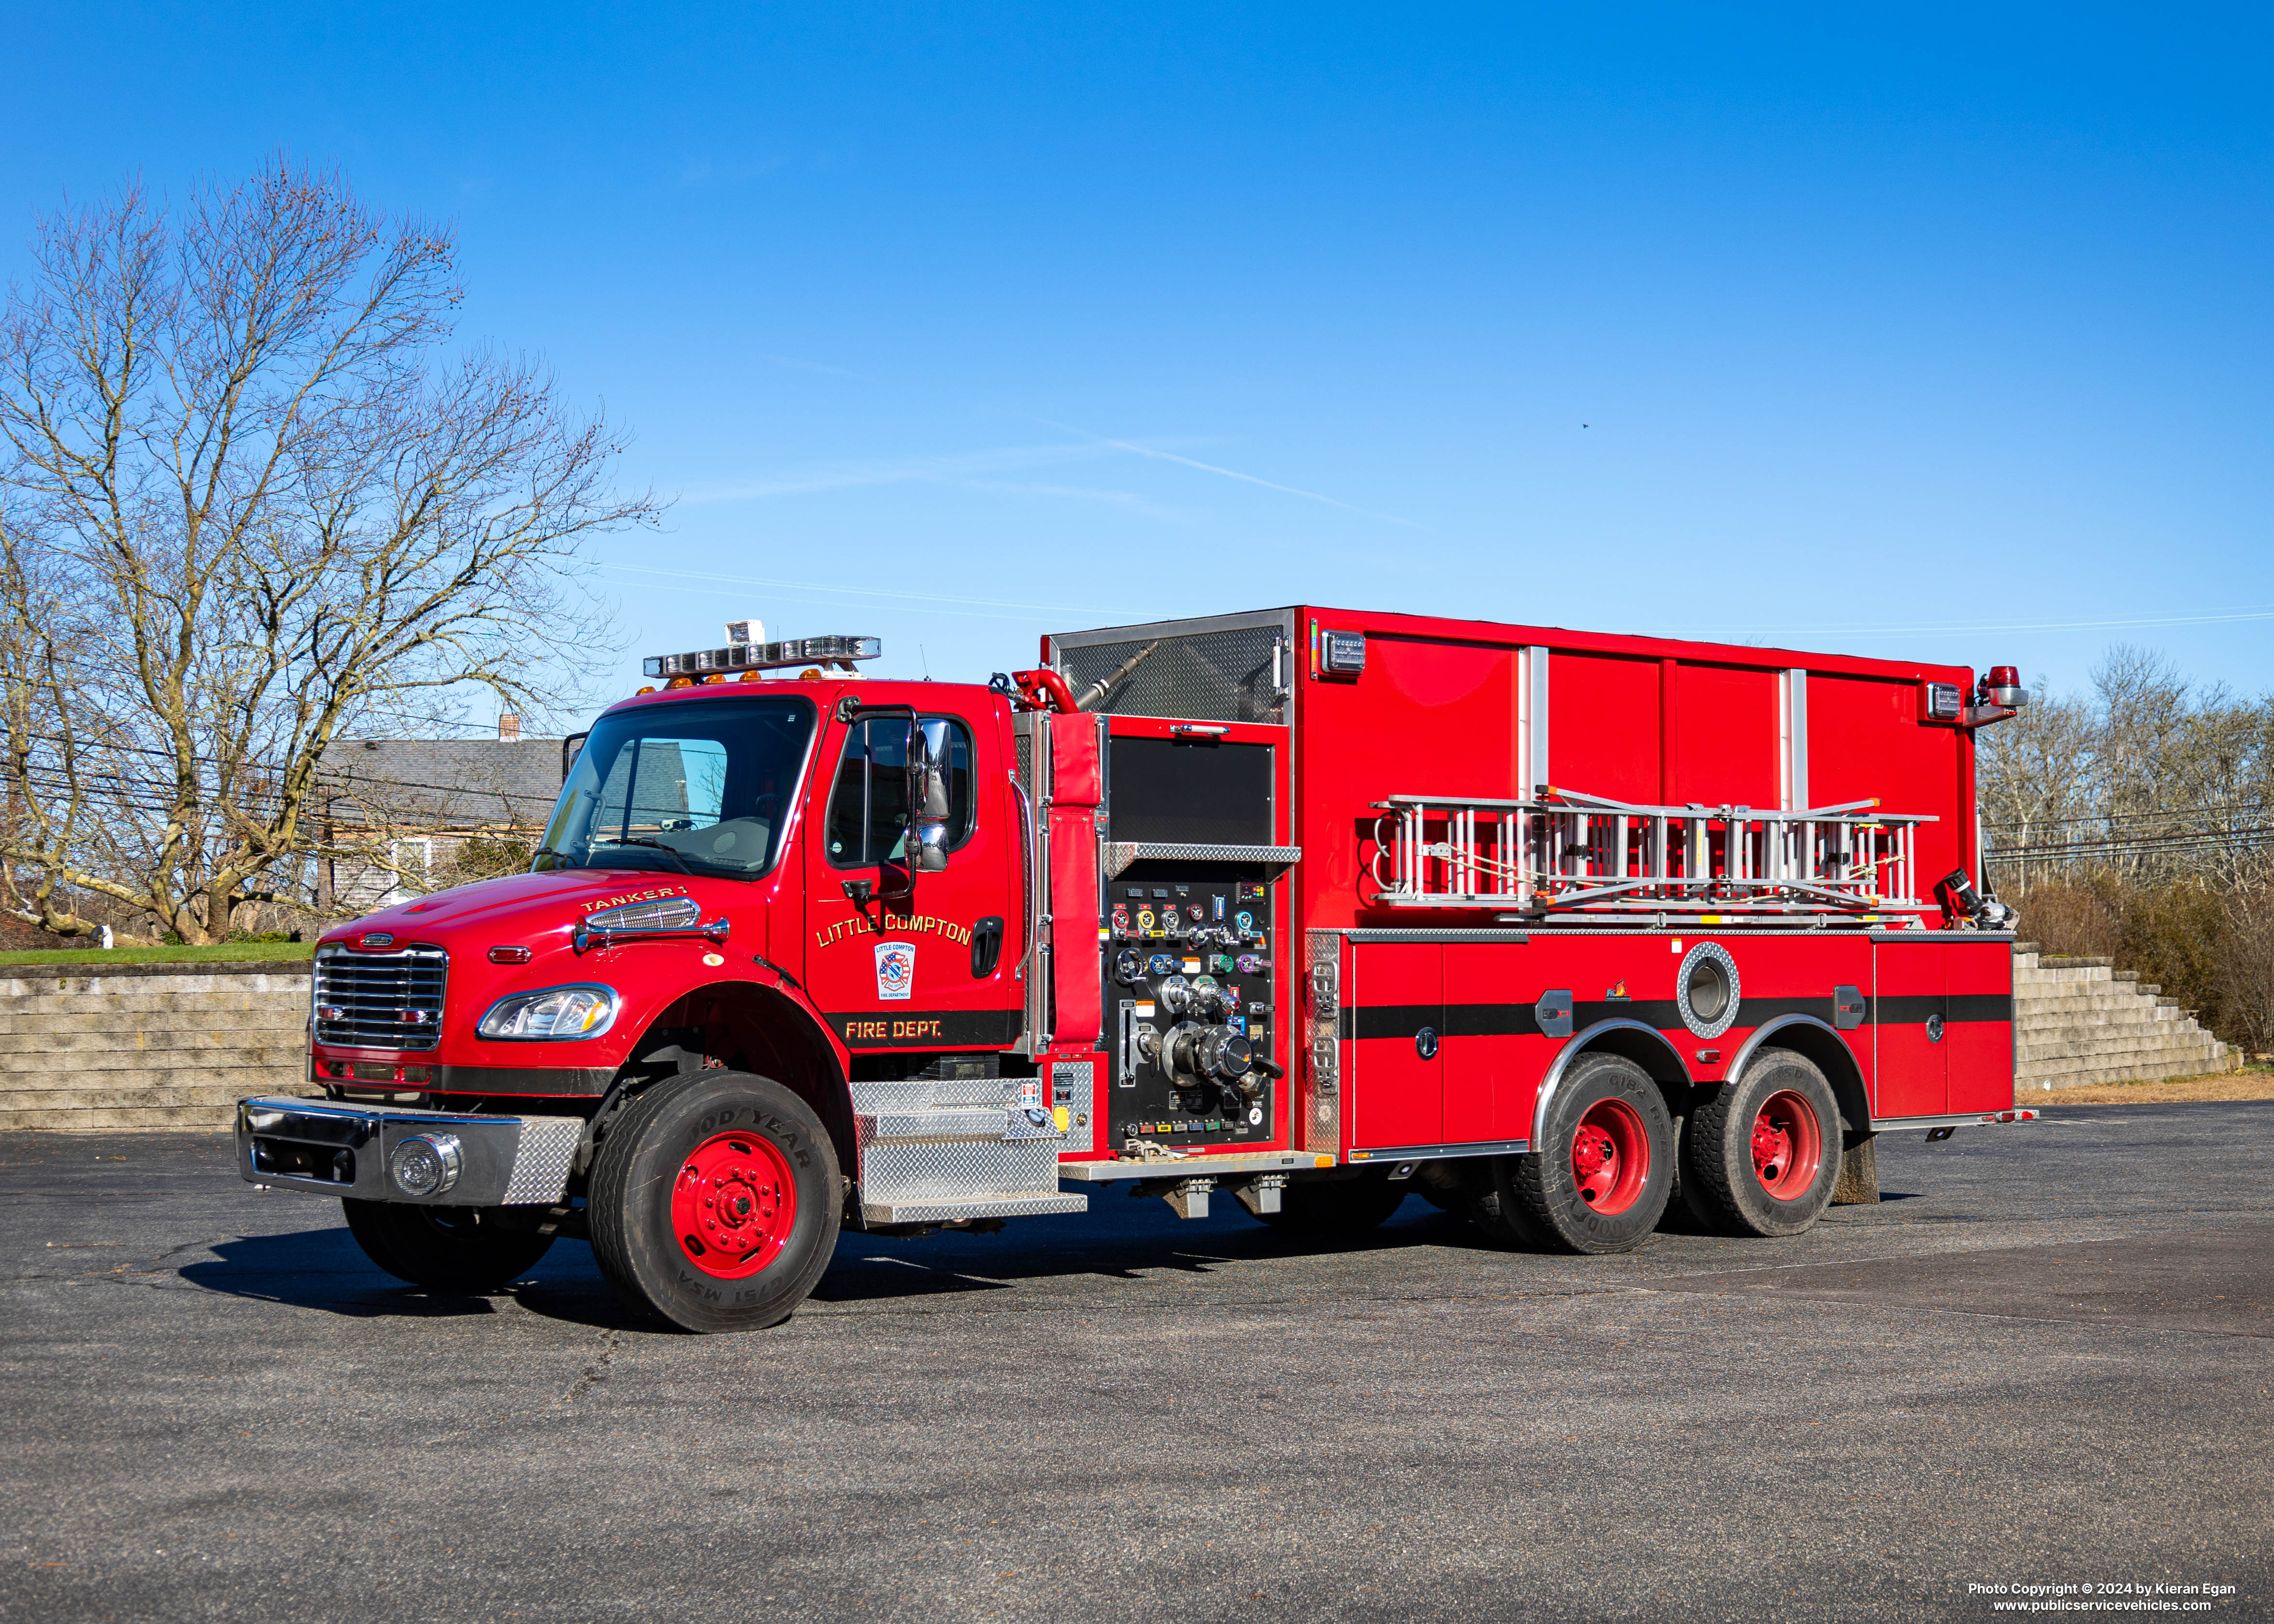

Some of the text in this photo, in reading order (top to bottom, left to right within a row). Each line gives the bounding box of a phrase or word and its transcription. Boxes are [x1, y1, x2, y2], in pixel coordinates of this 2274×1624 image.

[580, 886, 689, 912] TANKER 1
[816, 914, 972, 948] LITTLE COMPTON
[876, 944, 892, 953] LITTLE
[846, 1020, 942, 1039] FIRE DEPT.
[1607, 1074, 1647, 1099] G182
[672, 1106, 812, 1170] OODYEAR
[677, 1268, 722, 1301] MSA
